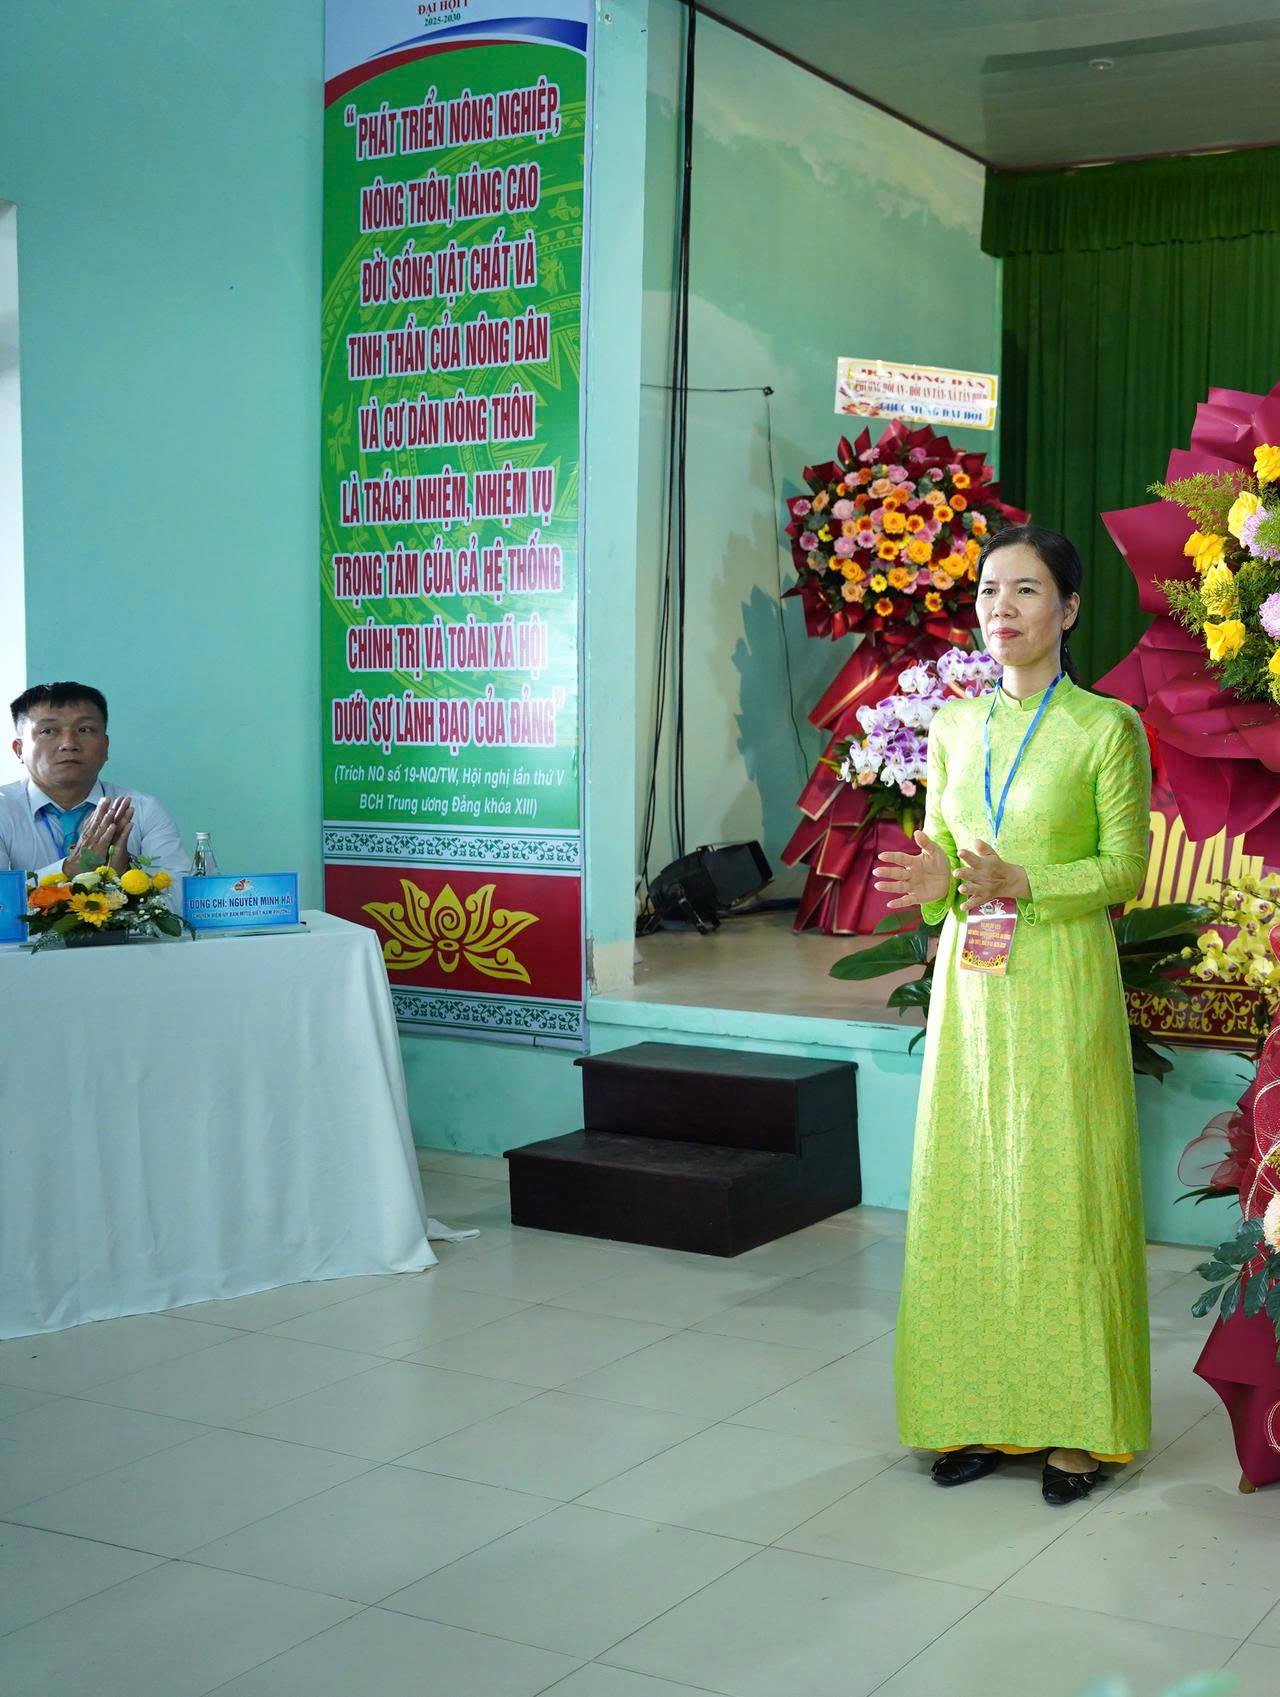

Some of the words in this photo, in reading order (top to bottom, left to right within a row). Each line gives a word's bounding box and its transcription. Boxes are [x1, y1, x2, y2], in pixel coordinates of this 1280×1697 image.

[425, 12, 461, 27] 2025-2030
[401, 88, 445, 151] TRIỂN
[449, 90, 493, 144] NÔNG
[498, 78, 560, 141] NGHIỆP,
[362, 179, 404, 230] NÔNG
[409, 171, 453, 224] THÔN,
[457, 165, 501, 217] NÂNG
[507, 164, 538, 210] CAO
[362, 251, 387, 303] ĐỜI
[392, 241, 433, 300] SỐNG
[438, 243, 466, 304] VẬT
[470, 230, 510, 291] CHẤT
[514, 232, 536, 286] VÀ
[348, 335, 382, 378] TINH
[387, 315, 426, 374] THẦN
[430, 314, 461, 370] CỦA
[465, 314, 510, 367] NÔNG
[514, 308, 548, 361] DÂN
[360, 398, 380, 450] VÀ
[383, 404, 405, 449] CƯ
[408, 393, 439, 446] DÂN
[443, 391, 487, 444] NÔNG
[492, 387, 534, 439] THÔN
[342, 473, 360, 524] LÀ
[364, 471, 412, 524] TRÁCH
[416, 467, 471, 528] NHIỆM,
[475, 463, 527, 526] NHIỆM
[531, 469, 553, 524] VỤ
[334, 554, 382, 606] TRỌNG
[387, 545, 418, 596] TÂM
[423, 538, 454, 595] CỦA
[458, 536, 479, 594] CẢ
[483, 540, 503, 602] HỆ
[507, 531, 562, 592] THỐNG
[348, 618, 393, 670] CHÍNH
[397, 626, 420, 679] TRỊ
[424, 617, 445, 669] VÀ
[448, 616, 489, 669] TOÀN
[493, 616, 514, 668] XÃ
[518, 613, 546, 679] HỘI
[334, 692, 368, 743] DƯỚI
[371, 697, 394, 751] SỰ
[396, 692, 435, 743] LÃNH
[439, 700, 470, 753] ĐẠO
[474, 686, 506, 744] CỦA
[334, 764, 364, 784] (Trích
[367, 765, 385, 782] NQ
[387, 764, 401, 783] số
[404, 766, 459, 785] 19-NQ/TW,
[462, 766, 481, 788] Hội
[484, 768, 509, 789] nghị
[513, 767, 530, 786] lần
[533, 767, 553, 786] thứ
[556, 769, 565, 786] V
[359, 794, 384, 810] BCH
[387, 794, 418, 816] Trung
[451, 794, 481, 818] Đảng
[484, 796, 511, 815] khóa
[515, 798, 538, 819] XIII)
[260, 895, 279, 906] MINH
